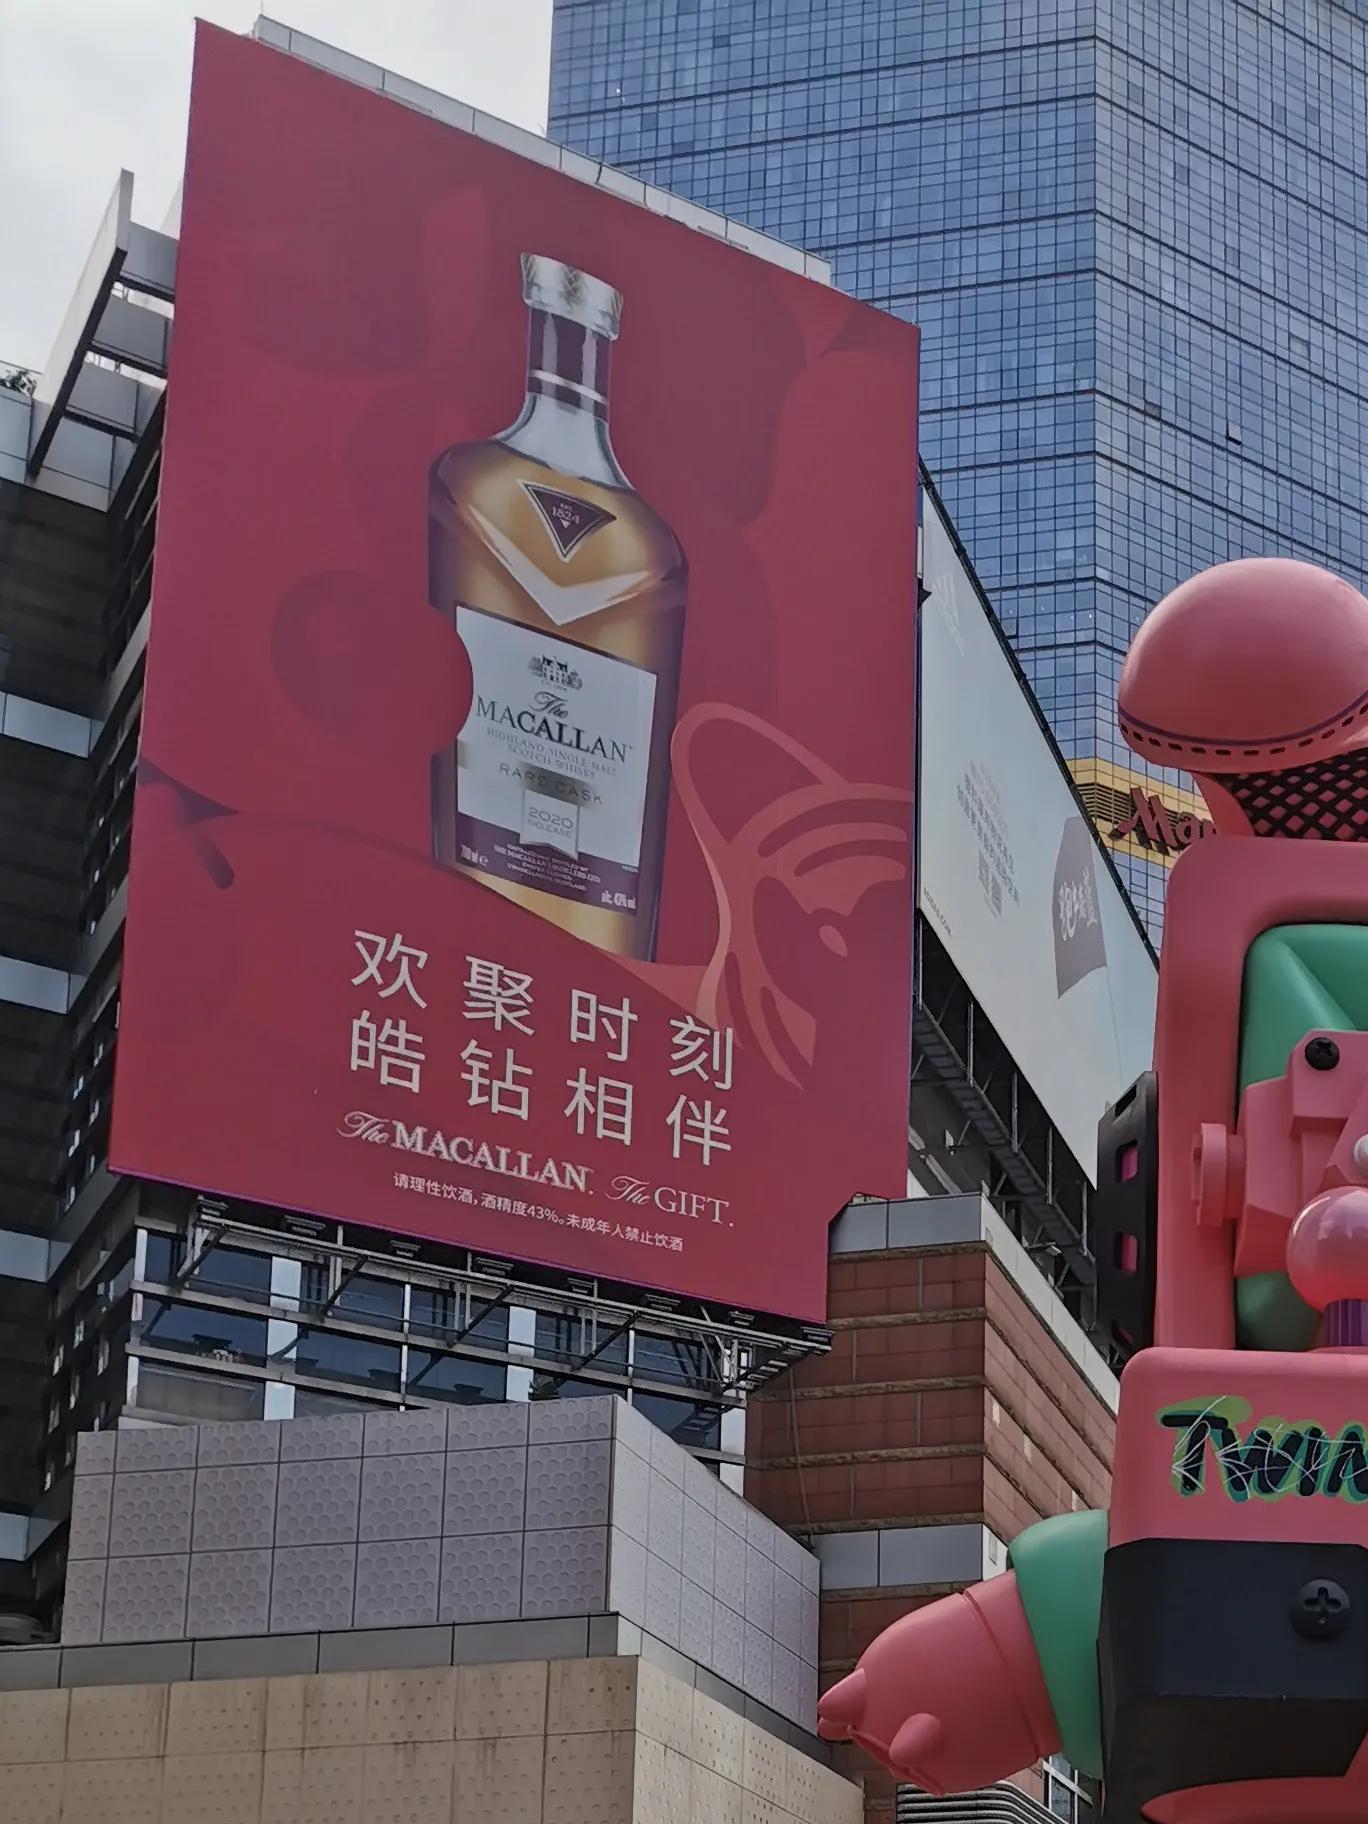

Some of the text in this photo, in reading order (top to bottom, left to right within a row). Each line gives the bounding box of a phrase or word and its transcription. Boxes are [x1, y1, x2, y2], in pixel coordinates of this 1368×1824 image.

[475, 694, 632, 764] MACALLAN
[529, 691, 569, 719] The
[487, 727, 618, 777] HIGHLAND SINGLE MALT
[508, 744, 551, 765] SCOTCH
[499, 762, 603, 804] RARE CASK
[527, 806, 574, 830] 2020
[350, 928, 734, 1091] 欢聚时刻
[349, 1009, 733, 1167] 皓钻相伴
[336, 1110, 390, 1145] The
[604, 1175, 650, 1205] The
